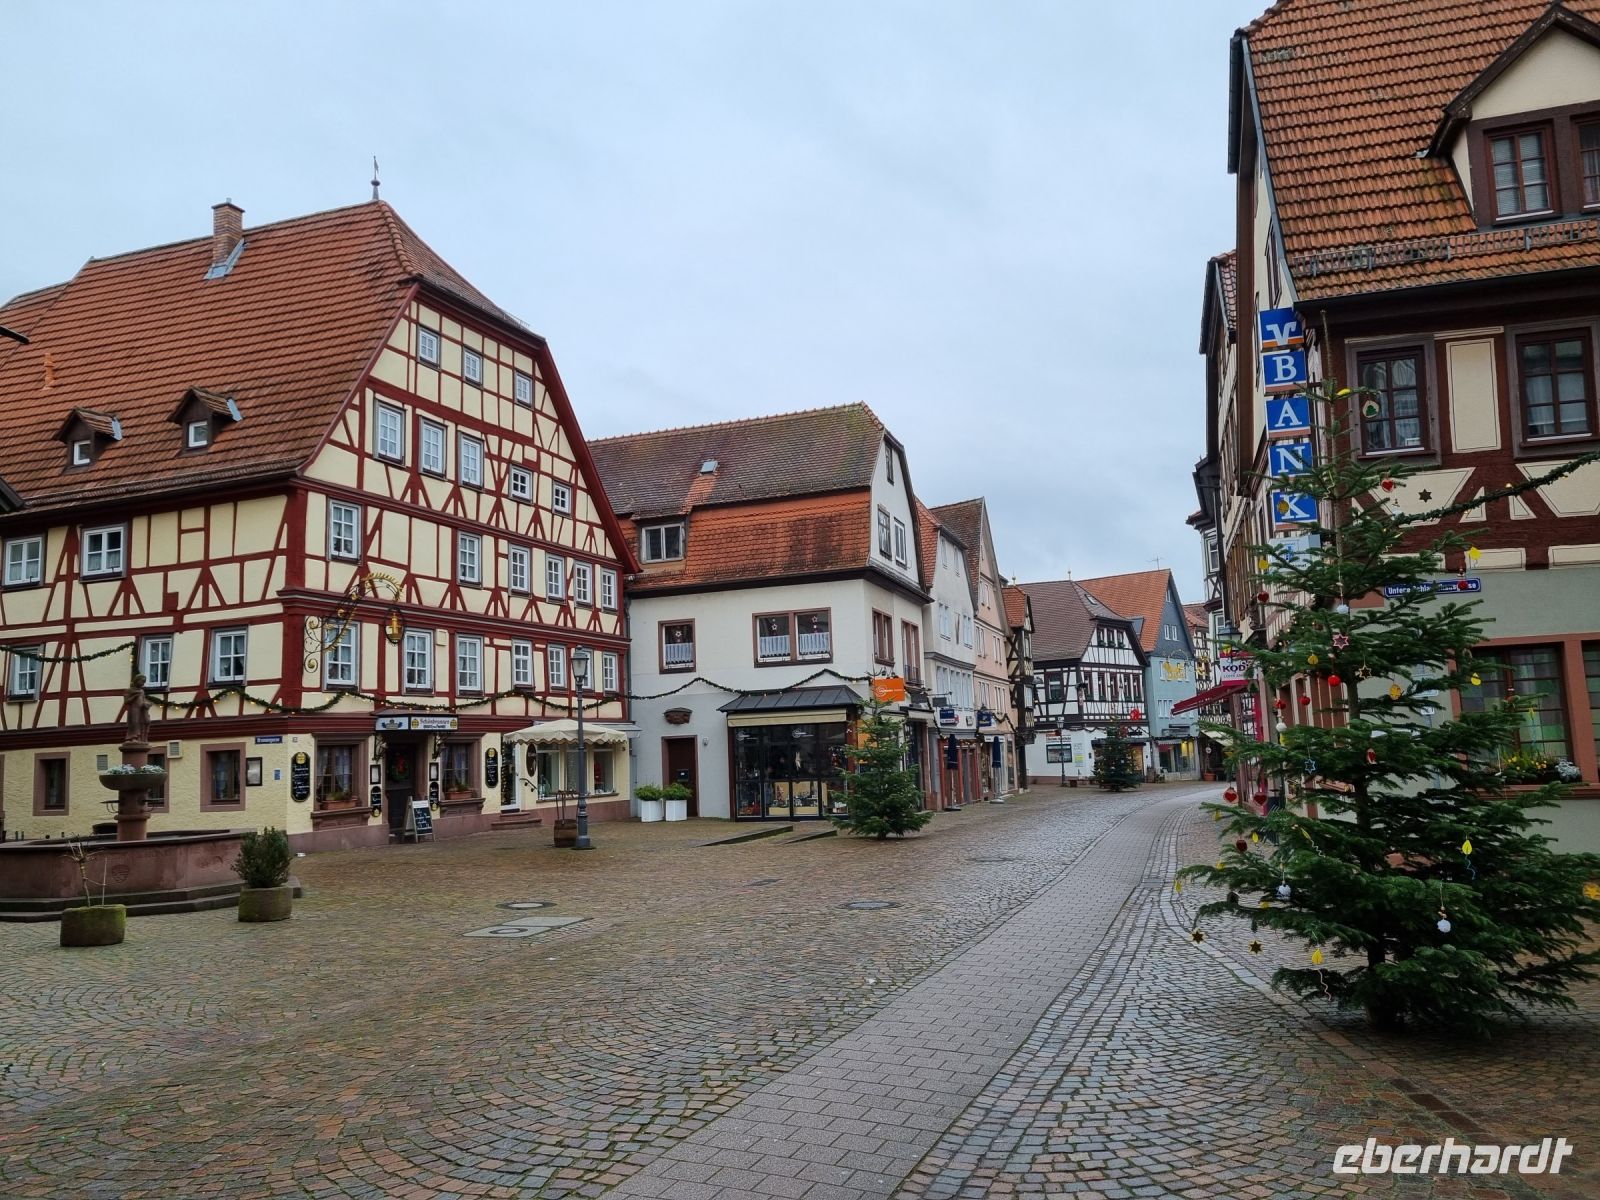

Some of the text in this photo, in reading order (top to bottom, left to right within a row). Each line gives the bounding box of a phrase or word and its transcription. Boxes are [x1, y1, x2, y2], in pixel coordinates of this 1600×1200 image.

[1272, 356, 1310, 520] BANK
[1388, 586, 1411, 595] Untere
[1222, 664, 1249, 672] KOD
